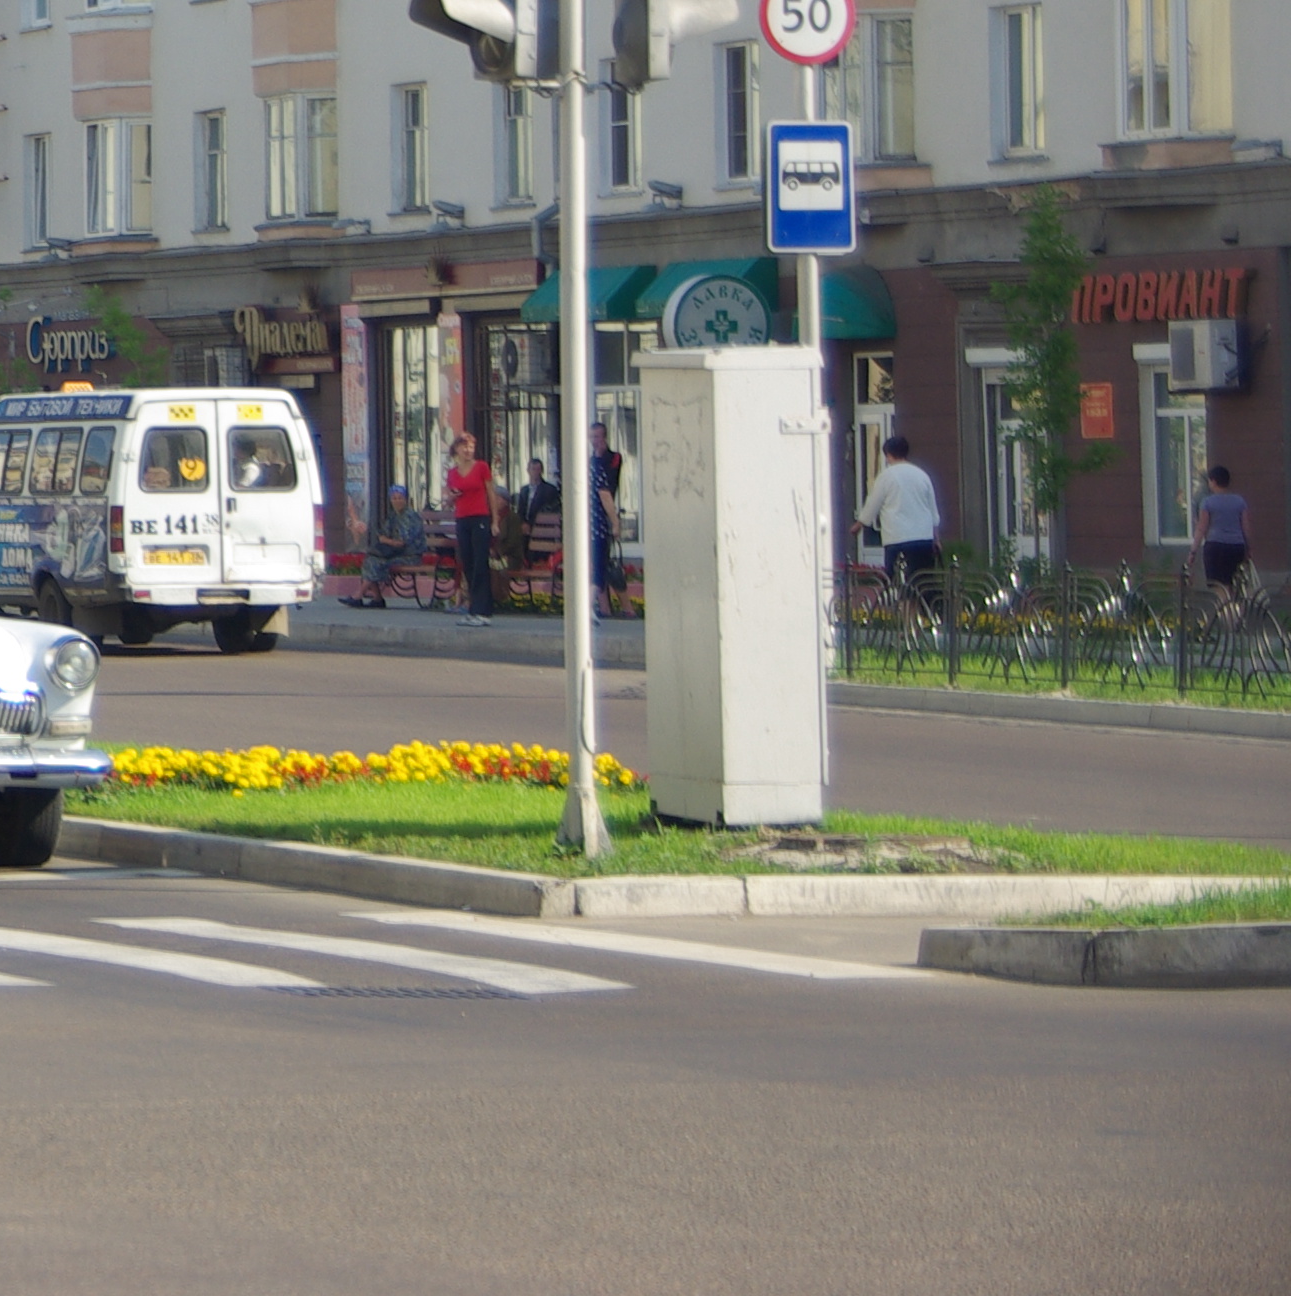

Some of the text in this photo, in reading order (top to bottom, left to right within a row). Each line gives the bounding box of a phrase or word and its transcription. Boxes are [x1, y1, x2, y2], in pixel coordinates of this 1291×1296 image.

[692, 285, 755, 311] ЛАВКА
[1072, 268, 1245, 324] ПРОВИАНТ
[26, 315, 109, 373] Сюрприз
[184, 457, 197, 478] 9
